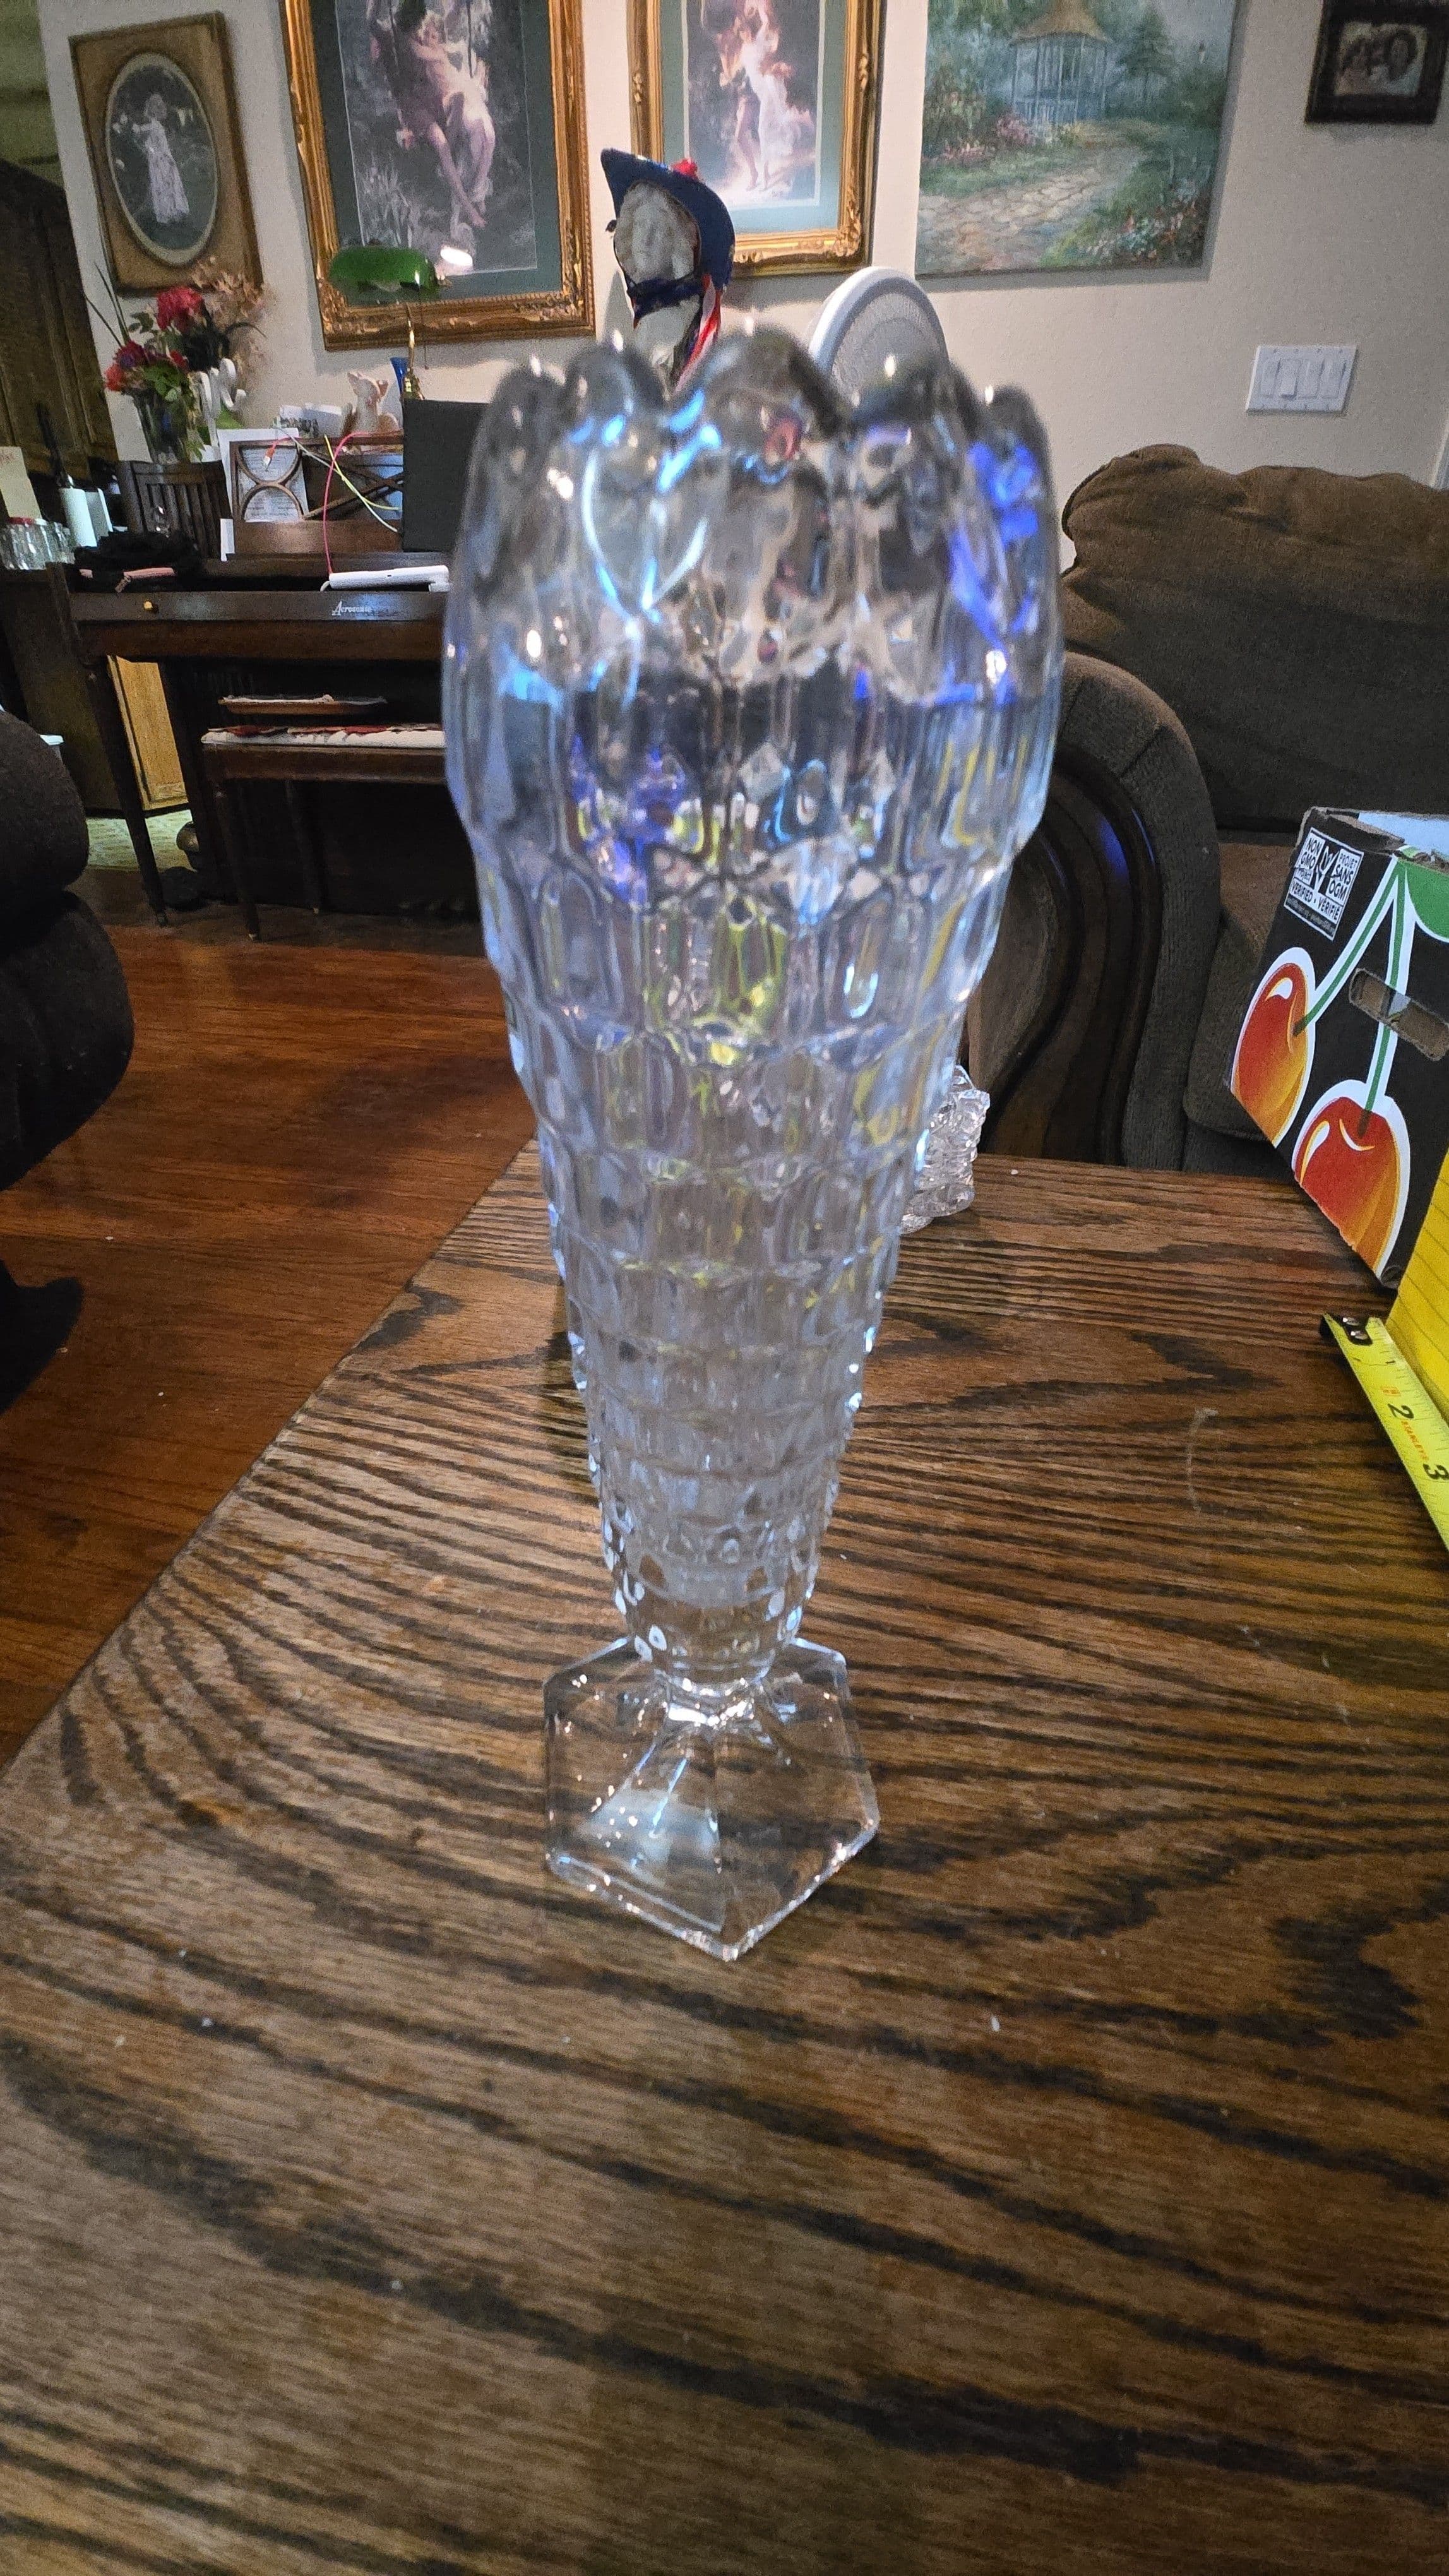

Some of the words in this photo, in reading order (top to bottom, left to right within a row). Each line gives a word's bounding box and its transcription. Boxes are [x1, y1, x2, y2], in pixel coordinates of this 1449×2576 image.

[1306, 837, 1321, 857] NON
[1301, 851, 1316, 869] GMO
[1335, 864, 1354, 885] SANS
[1291, 881, 1313, 903] VERIFIED
[1329, 880, 1347, 901] OGM
[1388, 1403, 1415, 1419] 2
[1423, 1464, 1449, 1481] 3
